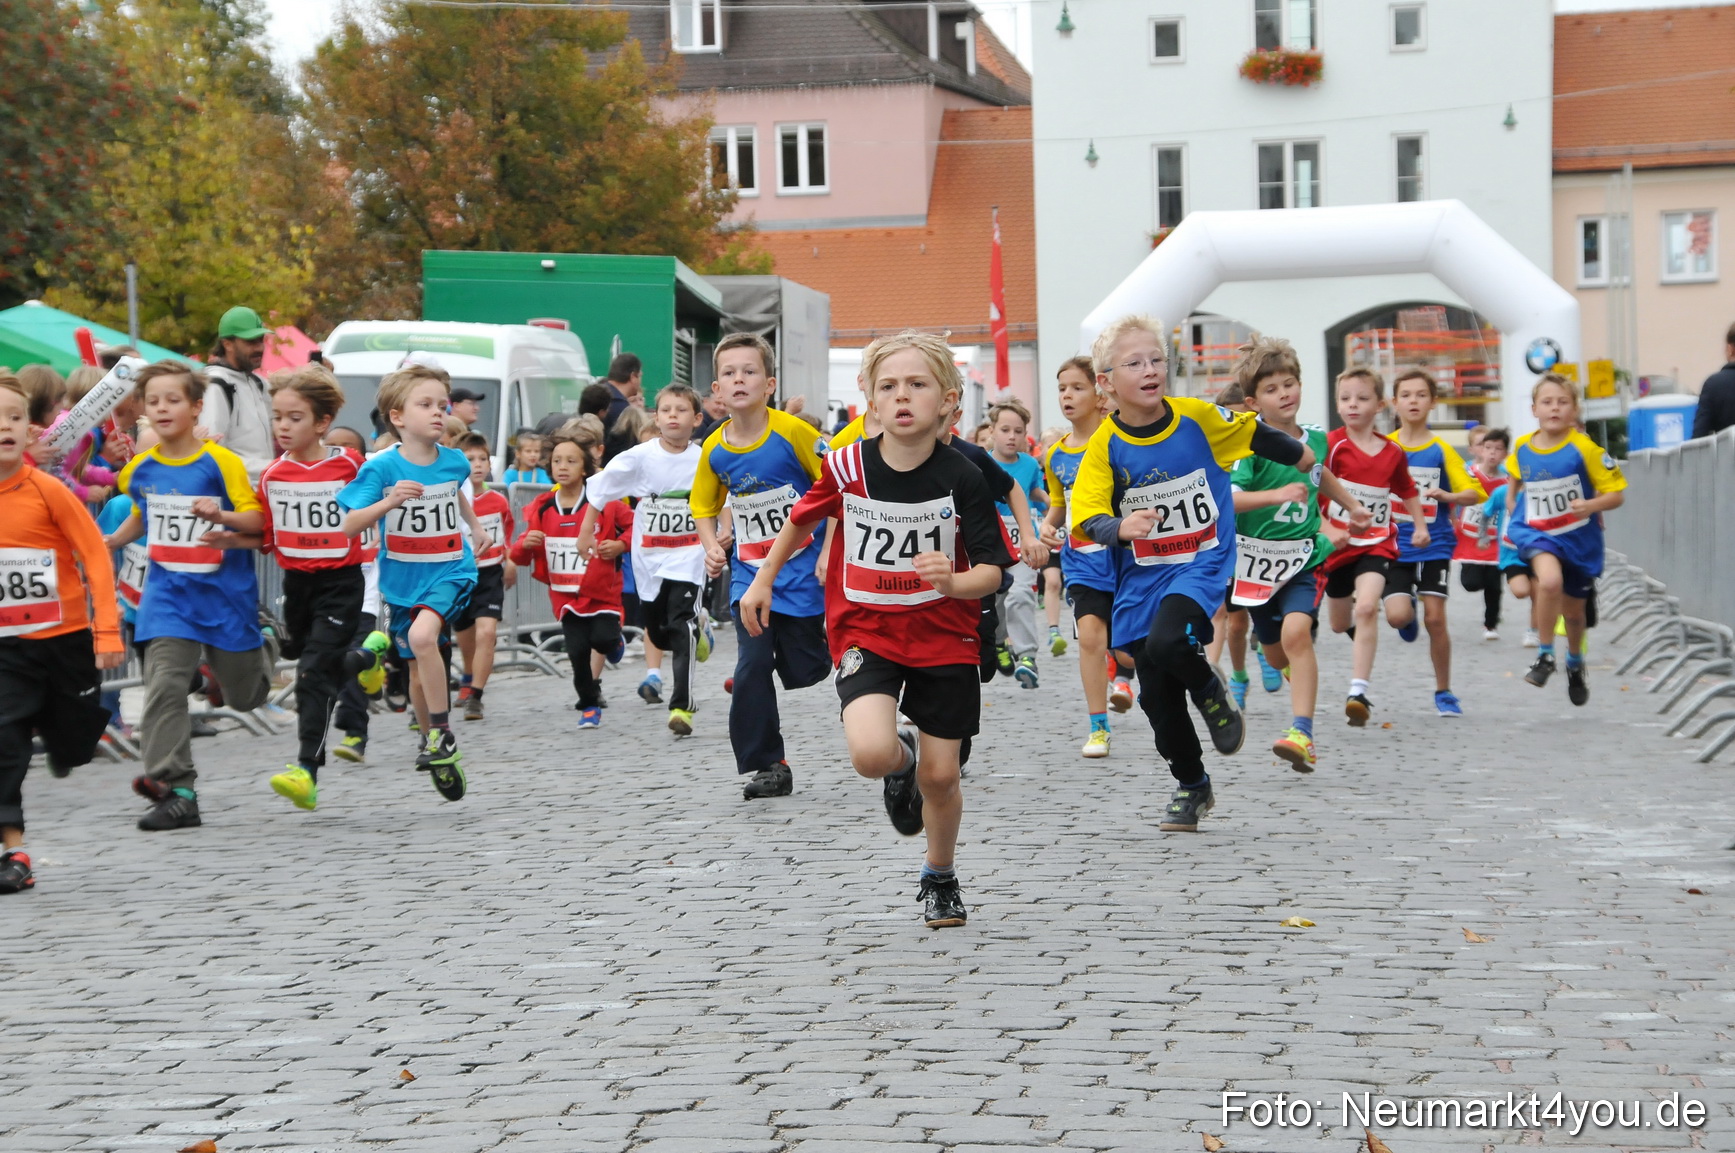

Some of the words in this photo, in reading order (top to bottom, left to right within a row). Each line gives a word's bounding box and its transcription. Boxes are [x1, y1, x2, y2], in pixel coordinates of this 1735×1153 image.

[749, 495, 786, 510] Neumarkt
[1121, 497, 1152, 505] PARTL
[1154, 483, 1197, 500] Neumarkt
[276, 500, 341, 528] 7168
[396, 501, 456, 533] 7510
[647, 512, 697, 533] 7026
[846, 503, 877, 521] PARTL
[880, 511, 936, 523] Neumarkt
[1131, 492, 1212, 533] 216
[297, 536, 318, 546] Max
[855, 521, 941, 566] 7241
[1237, 541, 1260, 553] PARTL
[1262, 547, 1300, 555] Neumarkt
[875, 576, 921, 591] Julius
